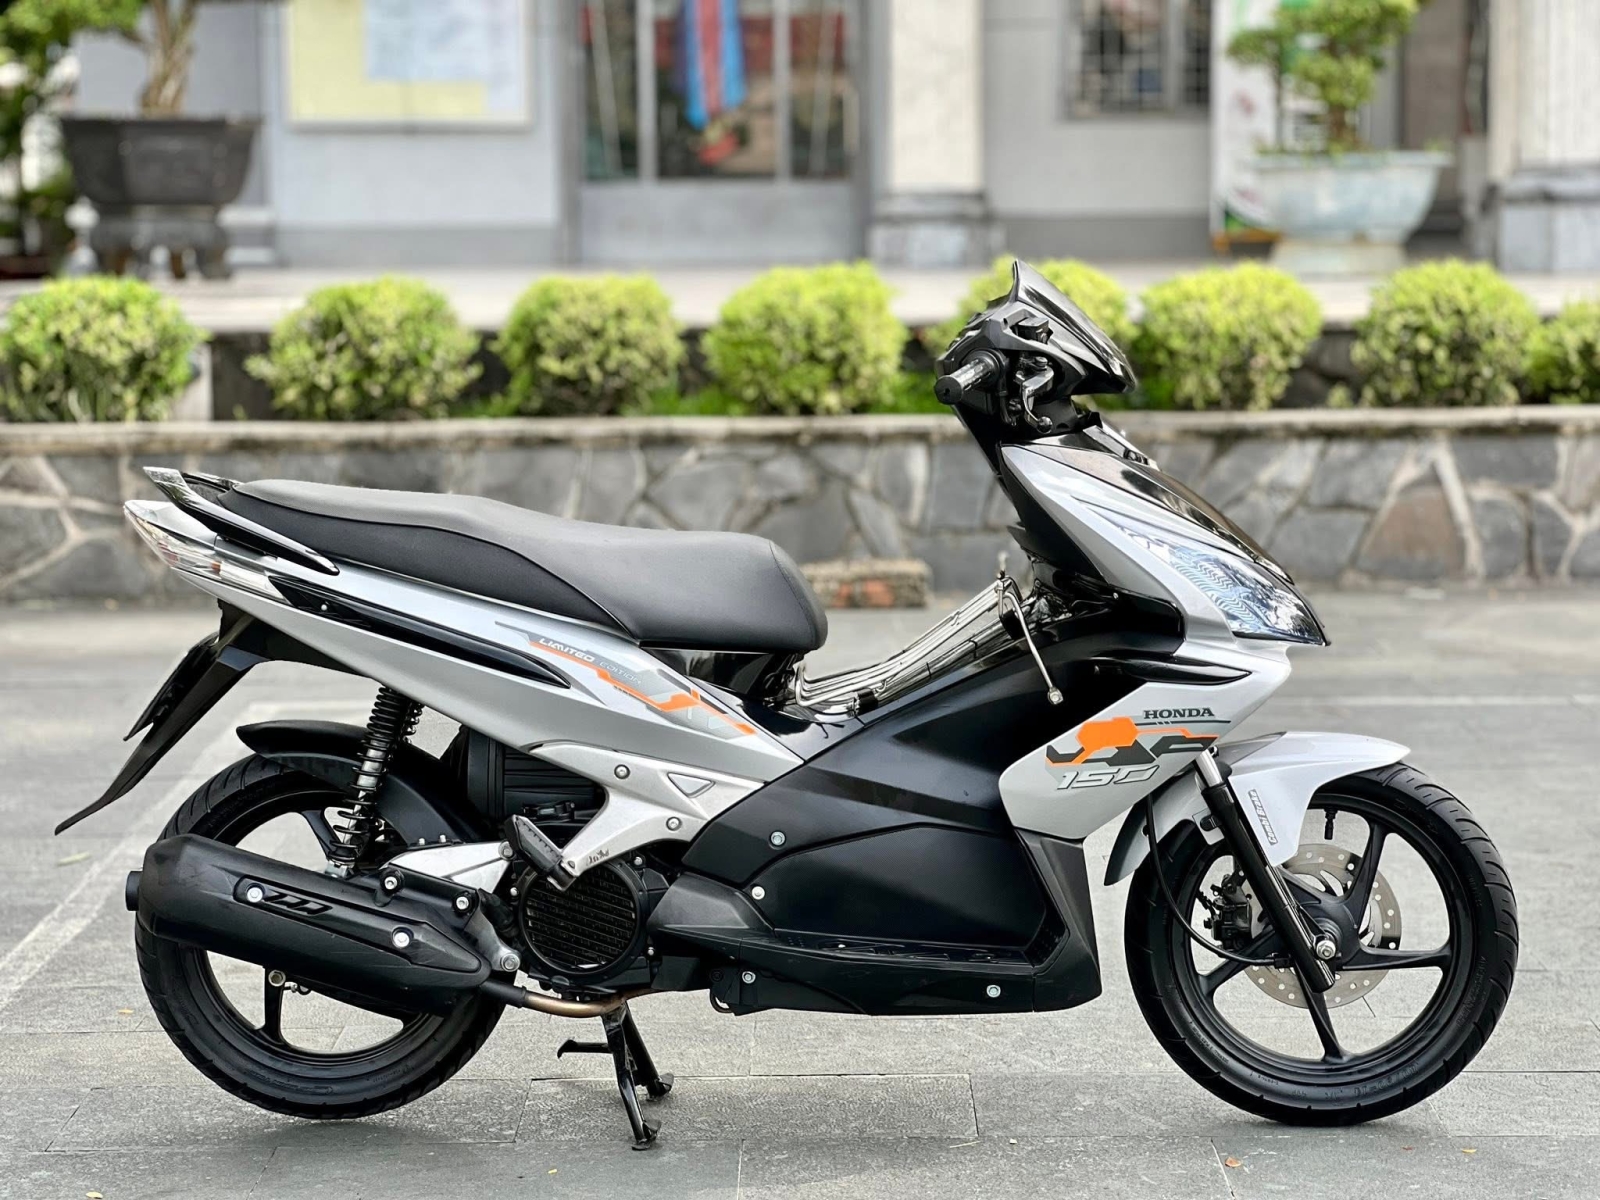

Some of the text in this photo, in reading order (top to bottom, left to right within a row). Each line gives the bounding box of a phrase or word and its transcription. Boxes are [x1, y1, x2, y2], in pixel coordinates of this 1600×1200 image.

[539, 638, 642, 684] LIMITED EDITION
[1143, 707, 1215, 719] HONDA
[1056, 764, 1160, 790] 150
[1250, 790, 1277, 844] Combi Brake
